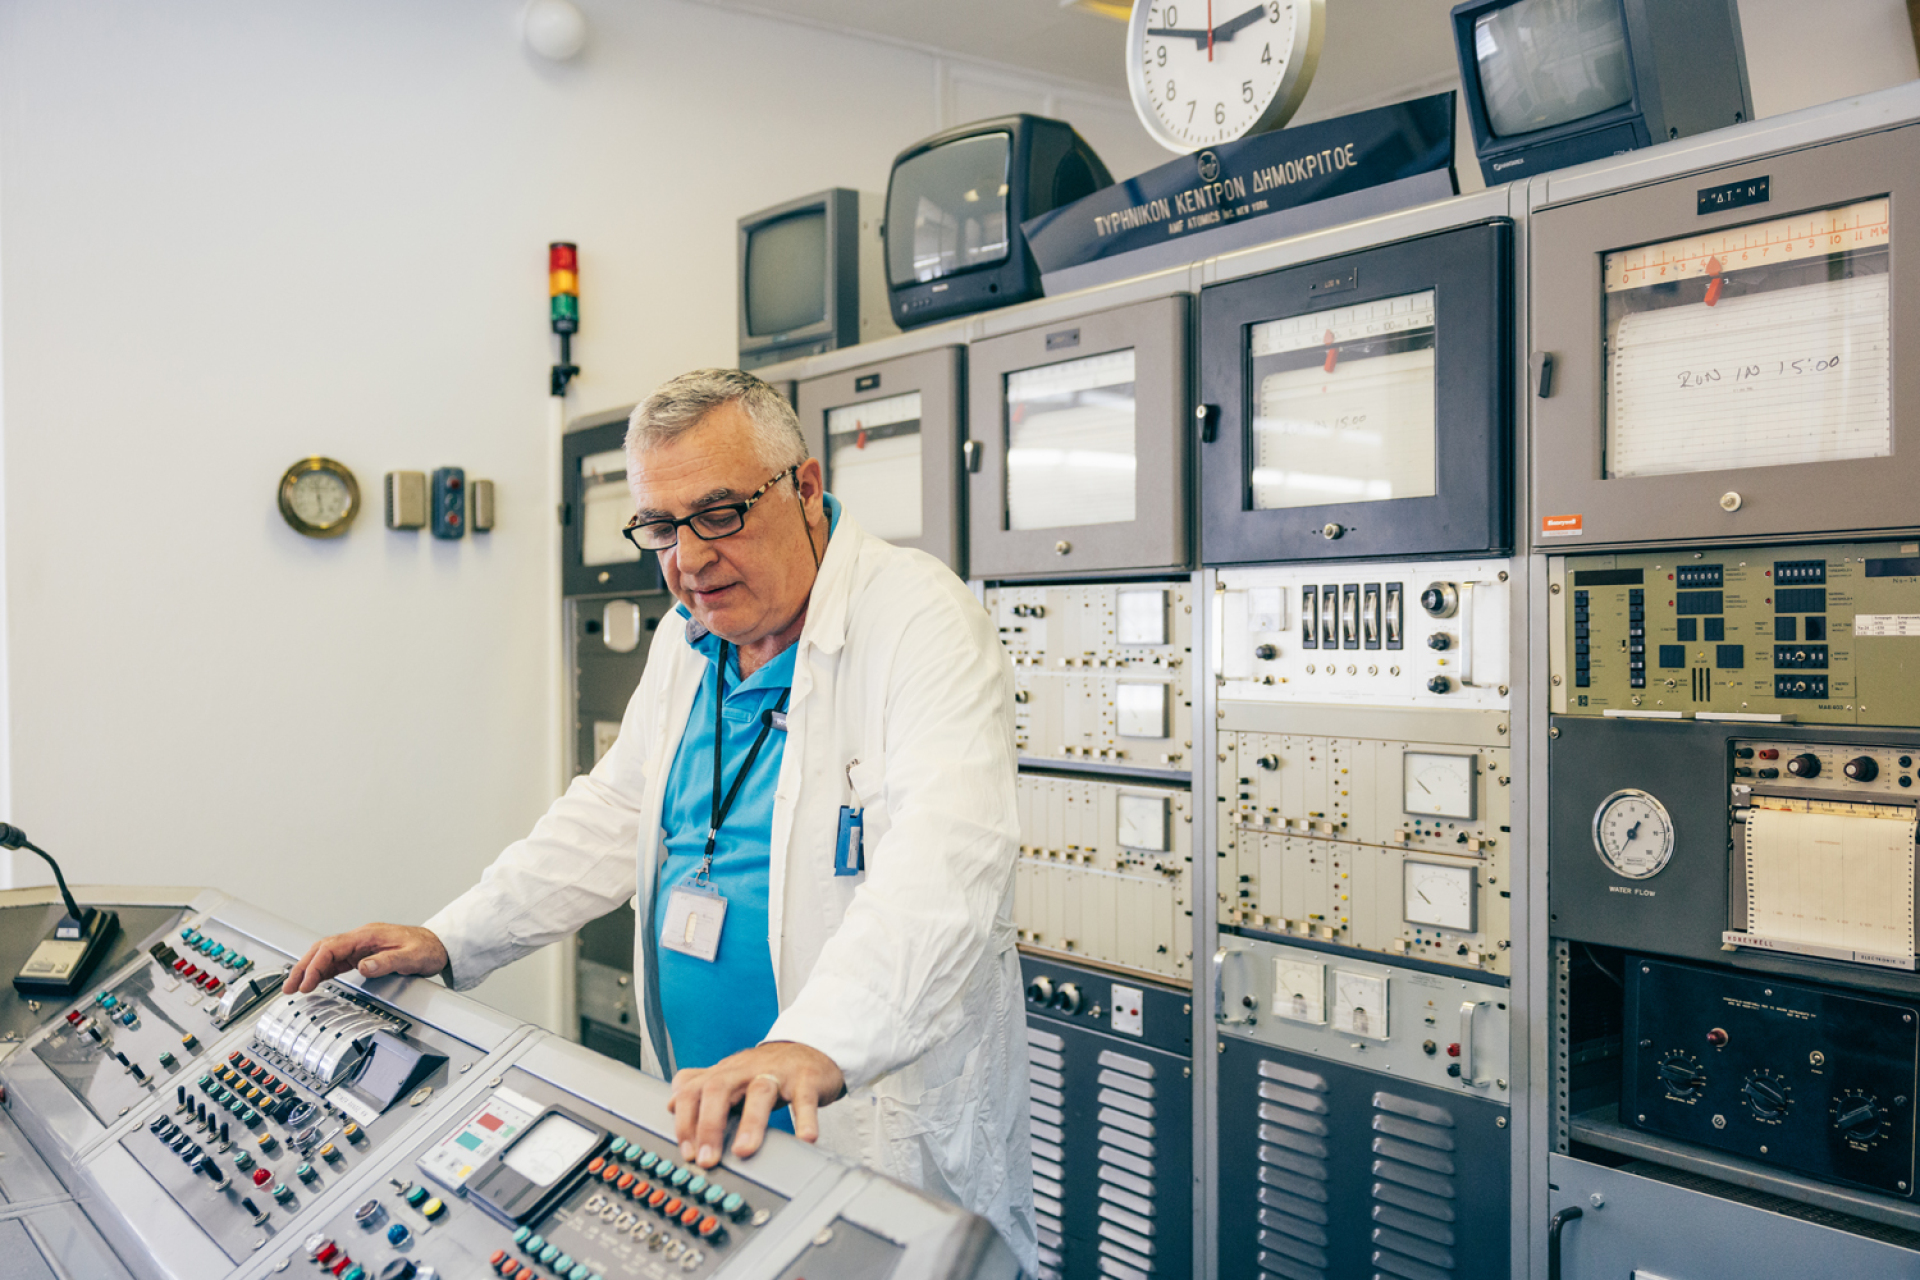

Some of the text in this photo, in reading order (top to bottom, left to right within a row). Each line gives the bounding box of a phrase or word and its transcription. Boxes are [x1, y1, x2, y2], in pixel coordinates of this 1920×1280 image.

[1162, 5, 1177, 29] 10
[1269, 0, 1280, 24] 3
[1157, 45, 1167, 67] 9
[1261, 42, 1272, 65] 4
[1166, 79, 1176, 101] 8
[1242, 80, 1253, 104] 5
[1187, 100, 1196, 123] 7
[1215, 102, 1225, 124] 6
[1742, 252, 1748, 261] 6
[1785, 243, 1792, 252] 8
[1830, 234, 1841, 245] 10
[1736, 365, 1760, 381] IN
[1779, 355, 1840, 375] 15:00
[1609, 886, 1656, 897] WATER FLOW
[1728, 935, 1774, 948] HONEYWELL
